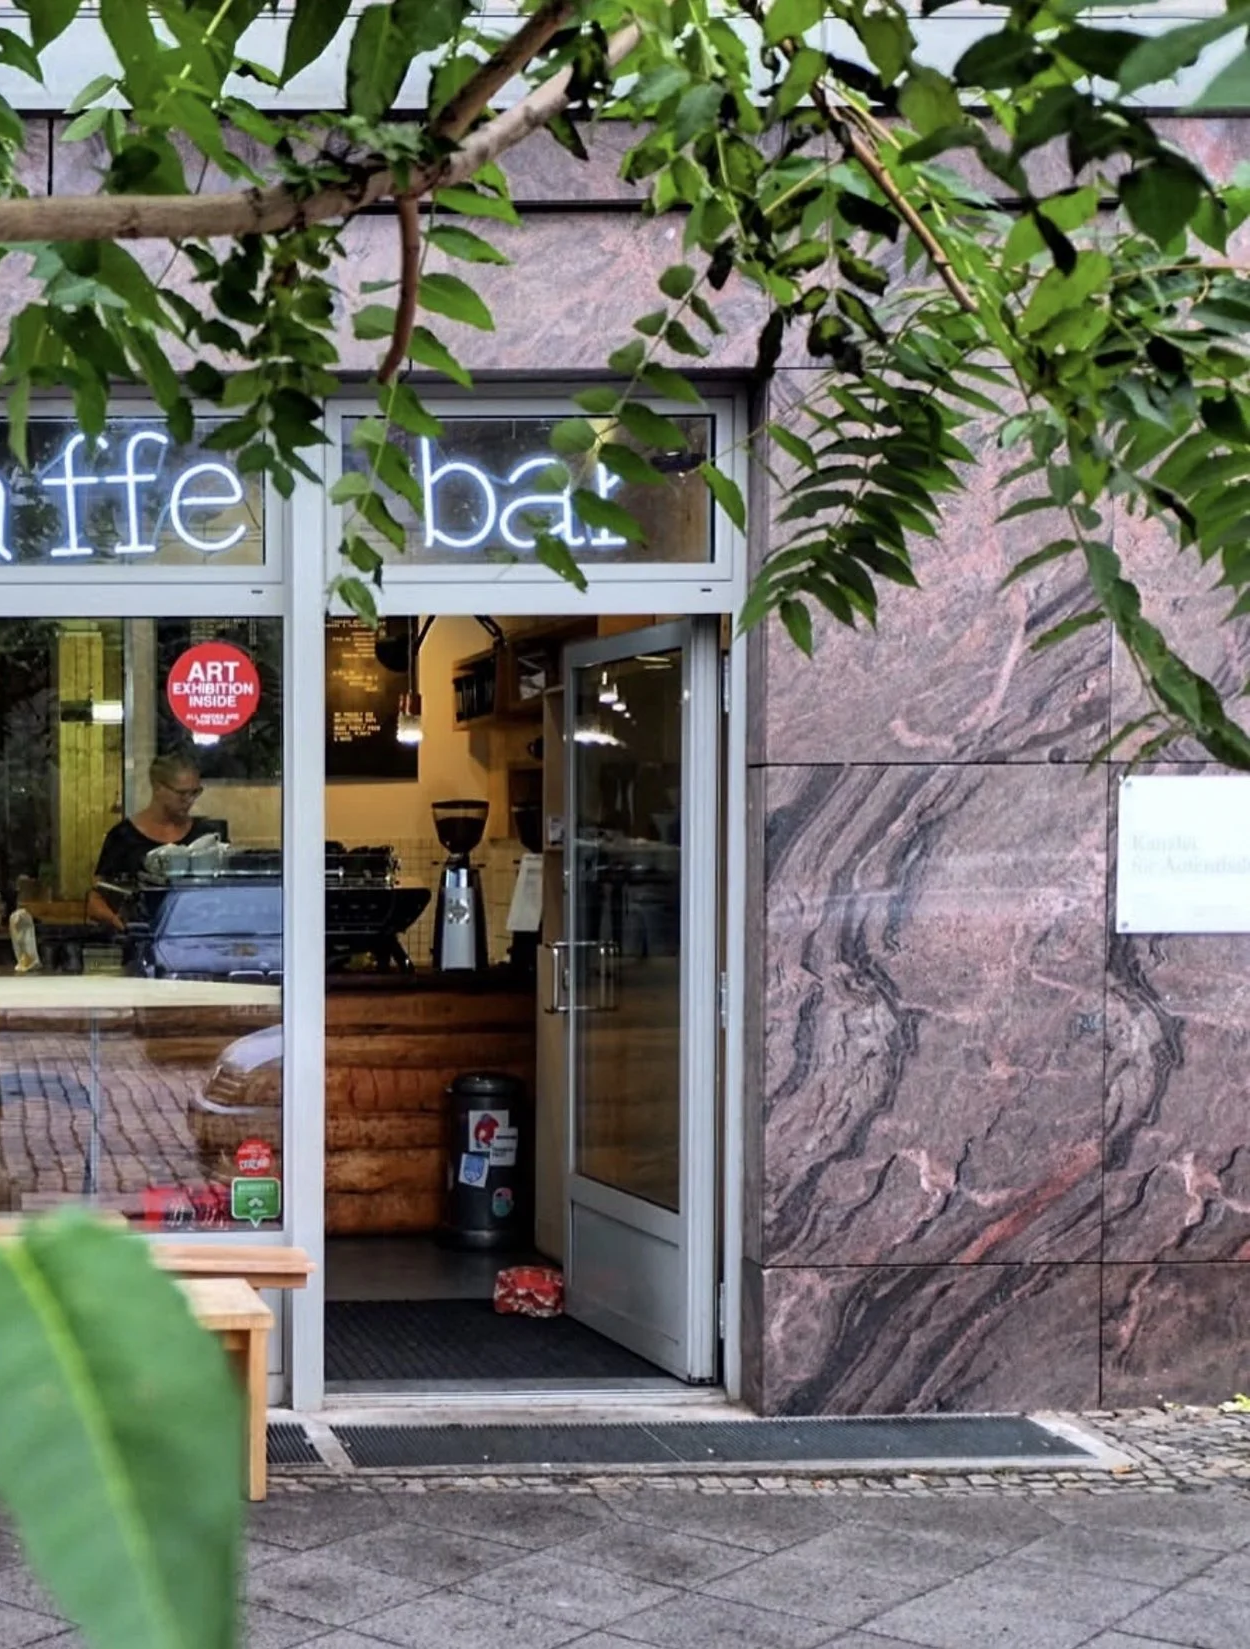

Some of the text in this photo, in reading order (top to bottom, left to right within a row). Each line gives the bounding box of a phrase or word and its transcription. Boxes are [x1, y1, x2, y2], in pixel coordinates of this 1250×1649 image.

[186, 660, 240, 682] ART
[172, 682, 254, 695] EXHIBITION
[188, 695, 237, 708] INSIDE
